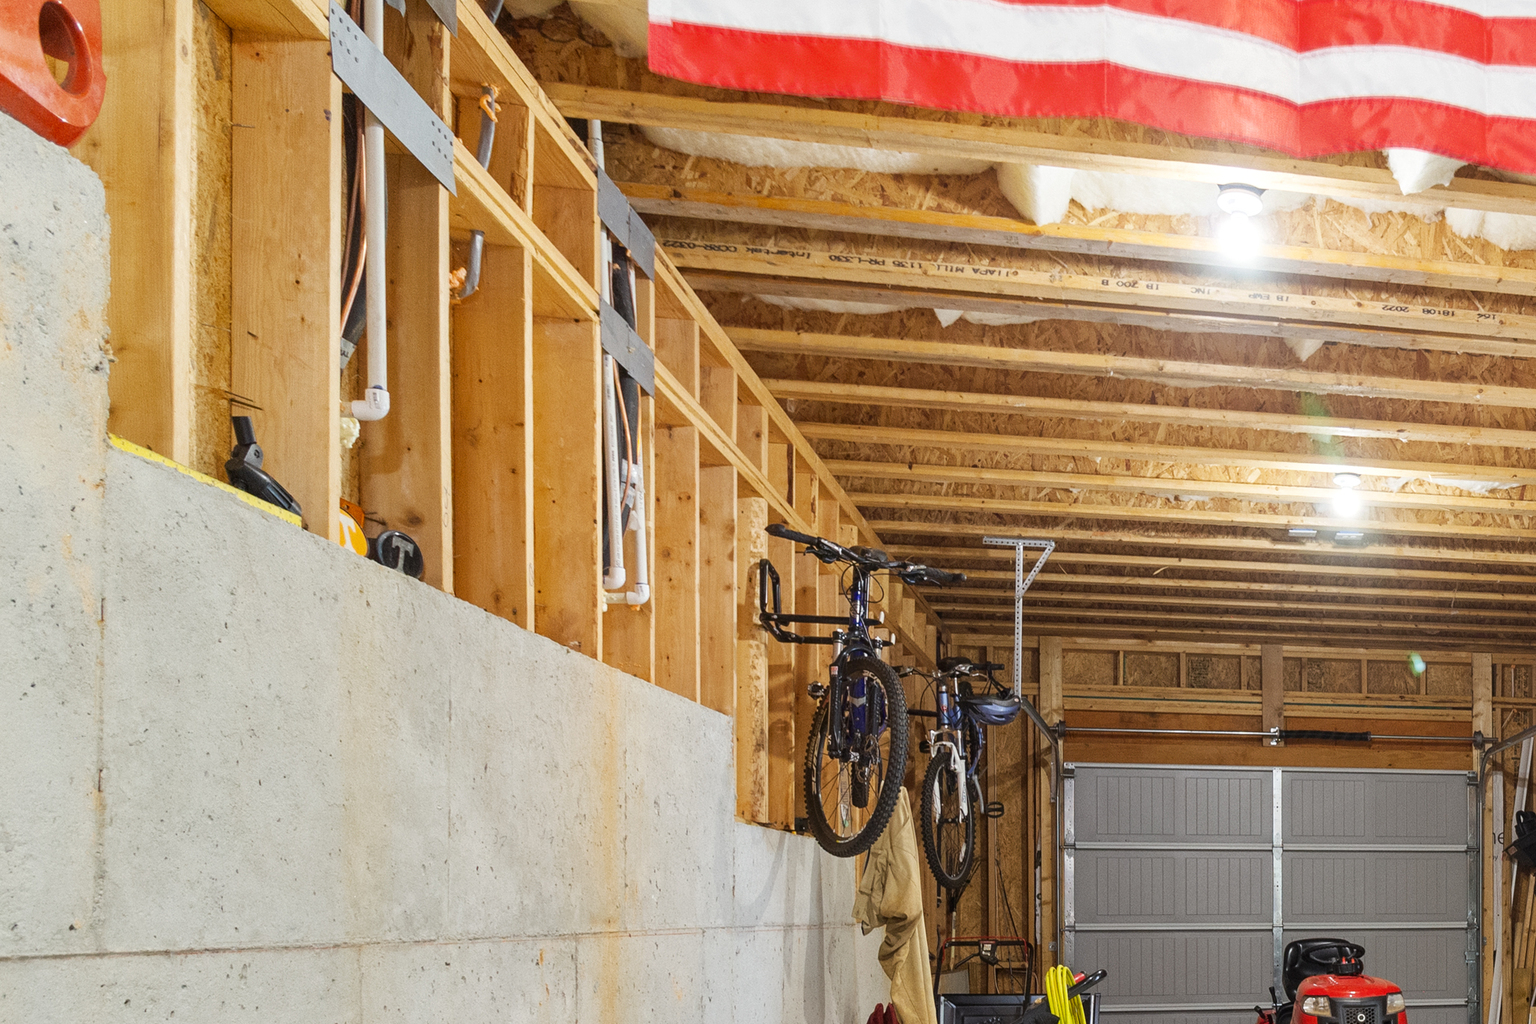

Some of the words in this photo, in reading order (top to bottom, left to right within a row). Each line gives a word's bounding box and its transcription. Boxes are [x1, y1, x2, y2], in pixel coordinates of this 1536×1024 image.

[746, 246, 811, 260] Intertek
[1101, 278, 1110, 287] B
[1381, 304, 1410, 313] 2022
[1422, 307, 1456, 318] 18:08
[391, 534, 415, 575] T
